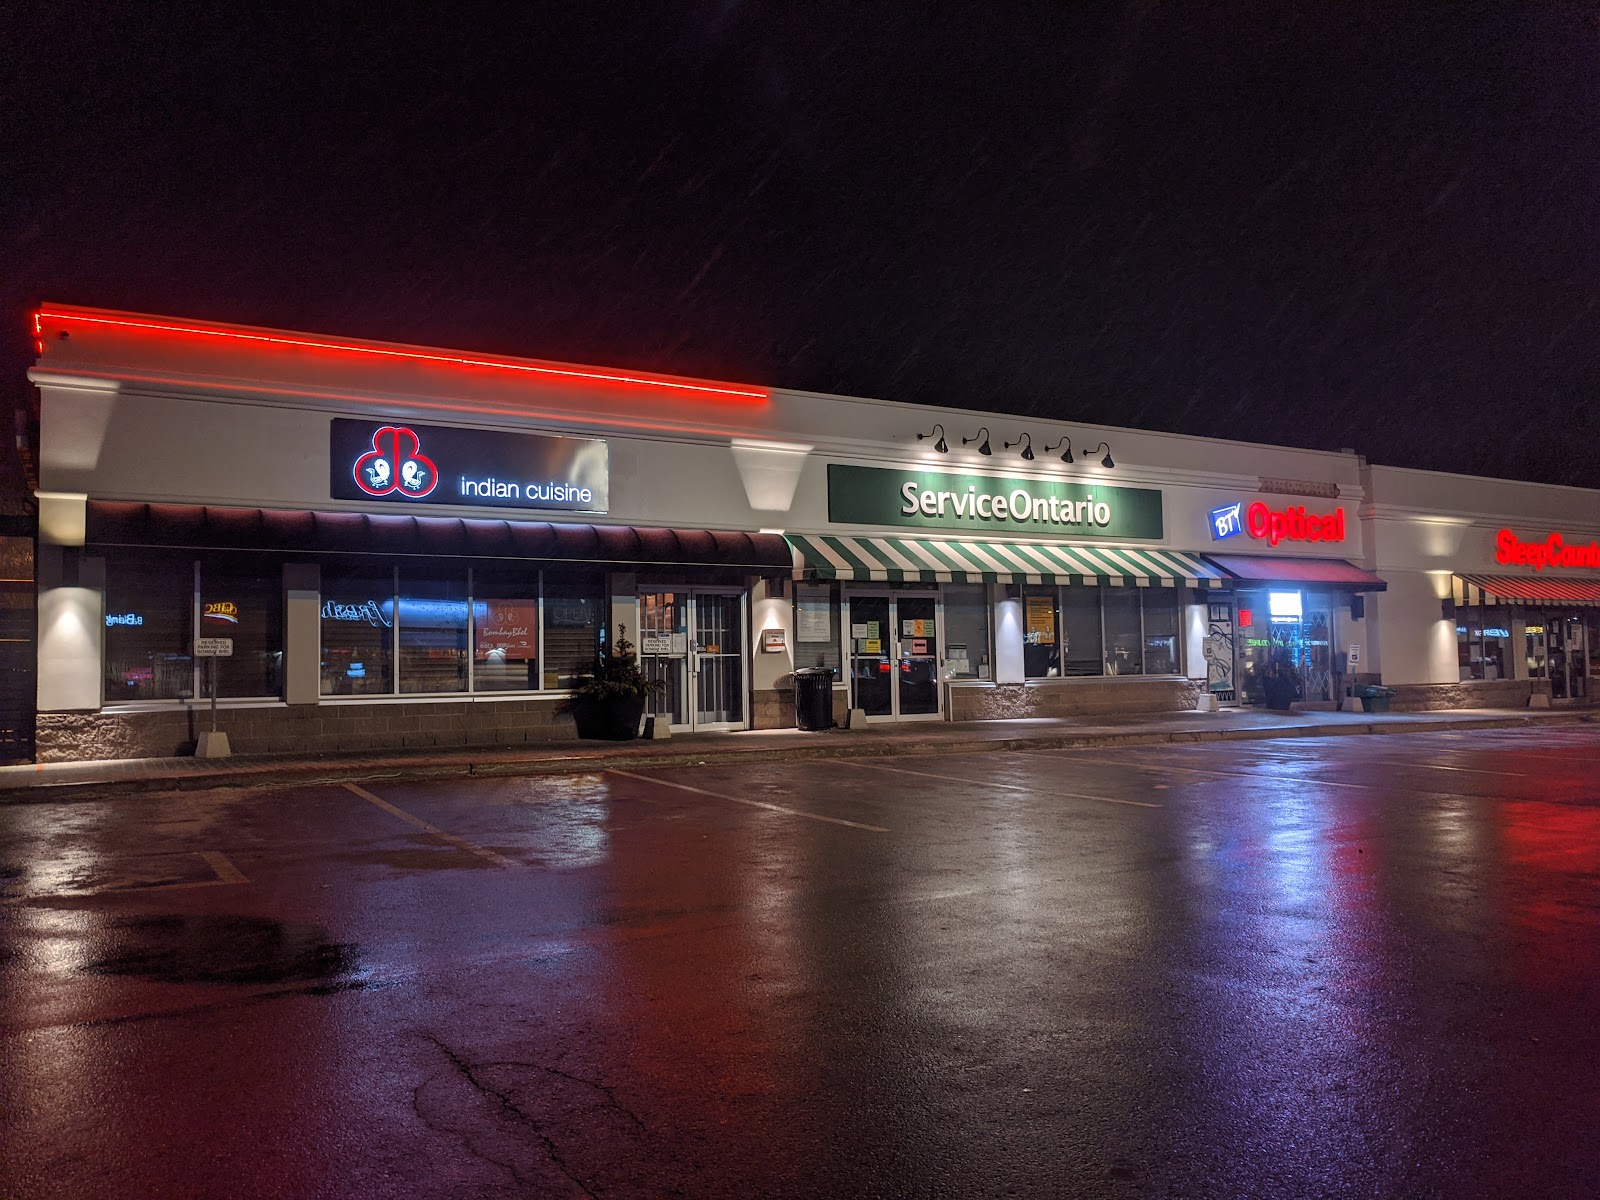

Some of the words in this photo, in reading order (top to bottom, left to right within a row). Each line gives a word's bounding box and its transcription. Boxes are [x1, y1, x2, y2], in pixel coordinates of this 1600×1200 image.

[461, 476, 520, 498] indian
[526, 482, 592, 503] cuisine
[902, 482, 1111, 525] ServiceOntario
[1248, 502, 1345, 546] Optical
[1496, 528, 1600, 572] SleepCount
